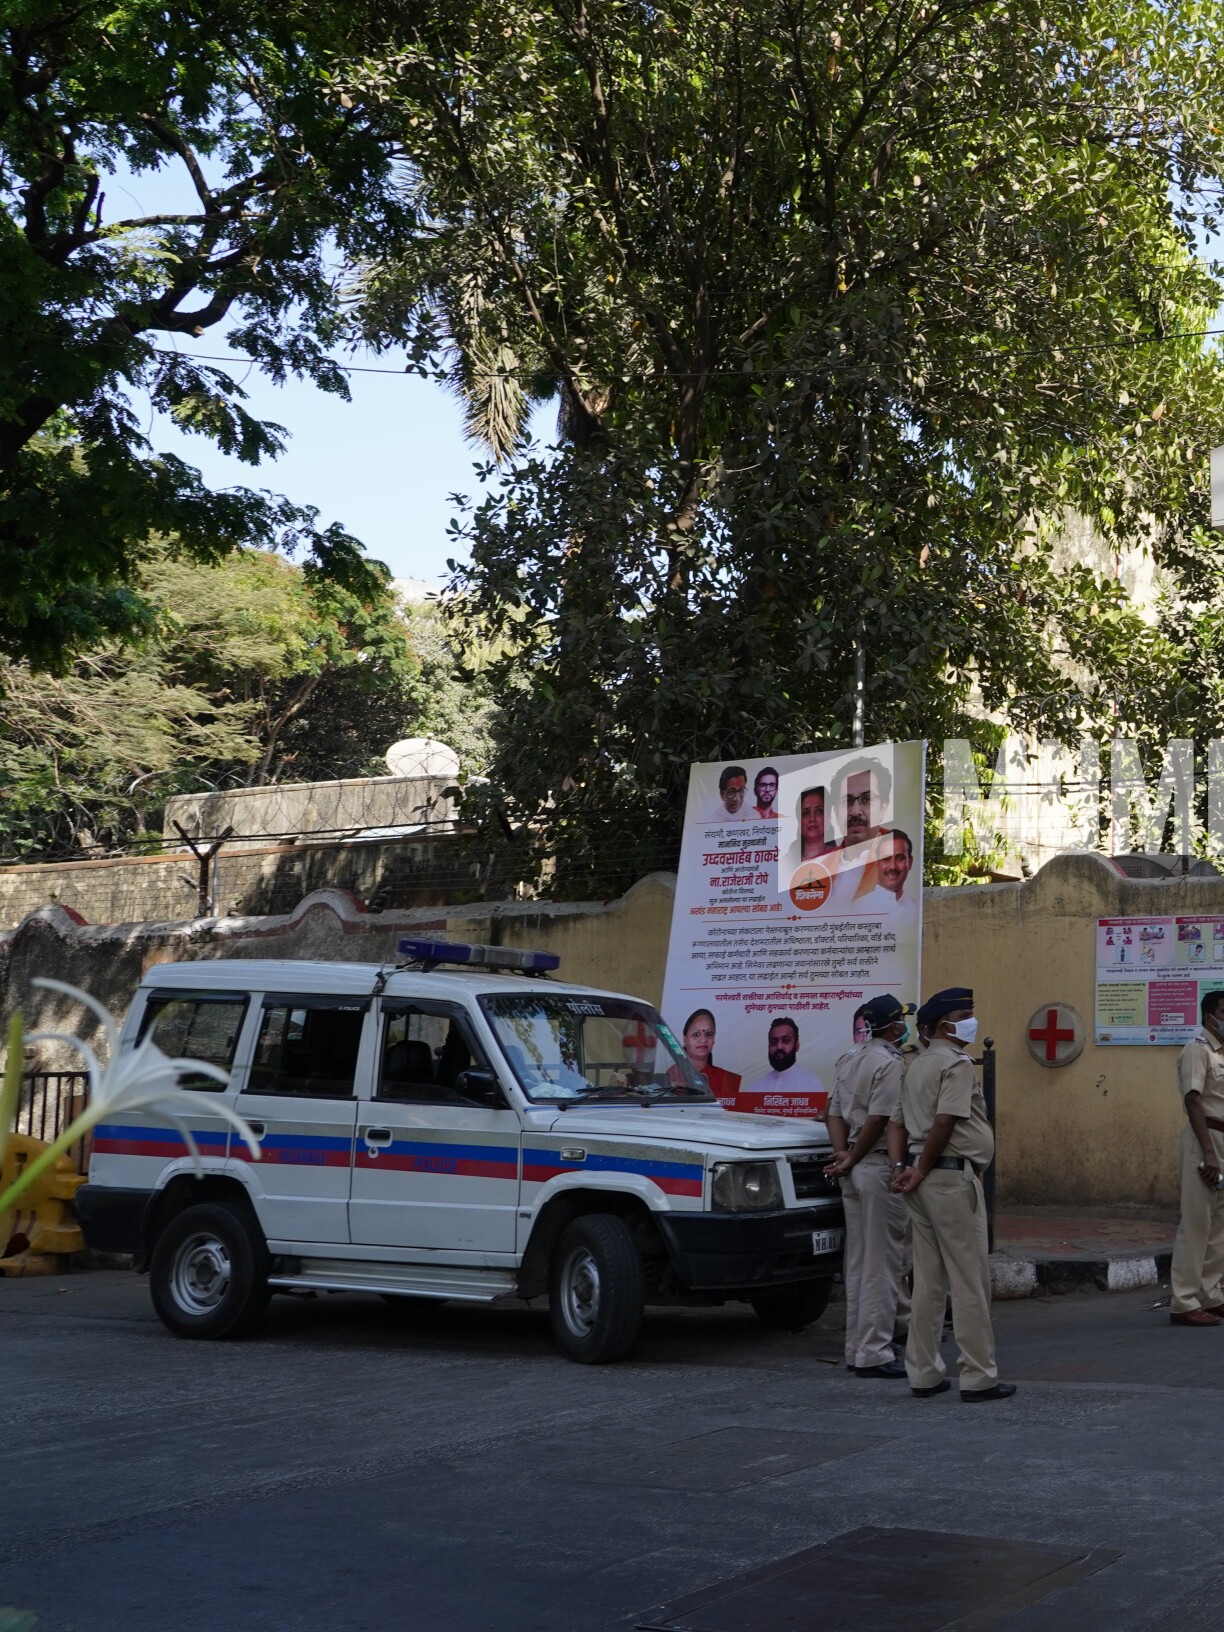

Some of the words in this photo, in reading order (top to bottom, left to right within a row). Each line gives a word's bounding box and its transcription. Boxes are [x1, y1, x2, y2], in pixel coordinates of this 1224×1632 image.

[754, 846, 779, 863] ठाकरे
[710, 872, 754, 887] ना.राजेशजी
[755, 872, 768, 884] टोपे
[795, 890, 824, 901] शिवसेना
[690, 906, 705, 915] अखंड
[707, 906, 728, 915] महाराष्ट्र
[729, 905, 751, 914] आपल्या
[752, 903, 768, 913] सोबत
[708, 927, 738, 936] कोरोनाच्या
[738, 926, 764, 935] संकटाला
[765, 925, 792, 936] नेस्तनाबूत
[794, 922, 828, 933] करण्यासाठी
[830, 922, 855, 934] मुंबईतील
[857, 922, 882, 932] कस्तुरबा
[733, 939, 749, 947] तसेच
[838, 933, 869, 943] परिचारिका,
[870, 932, 882, 942] वॉर्ड
[708, 950, 726, 959] सफाई
[727, 949, 751, 958] कर्मचारी
[752, 948, 768, 957] आणि
[769, 947, 792, 957] सहकार्य
[856, 946, 881, 955] आम्हाला
[706, 961, 729, 970] अभिमान
[745, 960, 765, 969] सिमेवर
[794, 958, 831, 968] जवानांसारखे
[832, 957, 846, 969] तुम्ही
[847, 958, 857, 966] सर्व
[859, 956, 878, 966] शक्तीने
[757, 972, 779, 981] लढाईत
[780, 970, 797, 980] आम्ही
[798, 970, 808, 979] सर्व
[809, 970, 830, 982] तुमच्या
[831, 969, 848, 978] सोबत
[715, 993, 741, 1002] परमेश्वरी
[742, 992, 764, 1001] शक्तीचा
[565, 998, 606, 1016] पोलीस
[744, 1003, 766, 1013] शुभेच्छा
[767, 1004, 787, 1013] तुमच्या
[788, 1002, 810, 1010] पाठीशी
[764, 1095, 789, 1106] निखिल
[791, 1097, 810, 1106] जाधव
[280, 1150, 326, 1165] MUMBAI
[414, 1158, 457, 1173] POLICE
